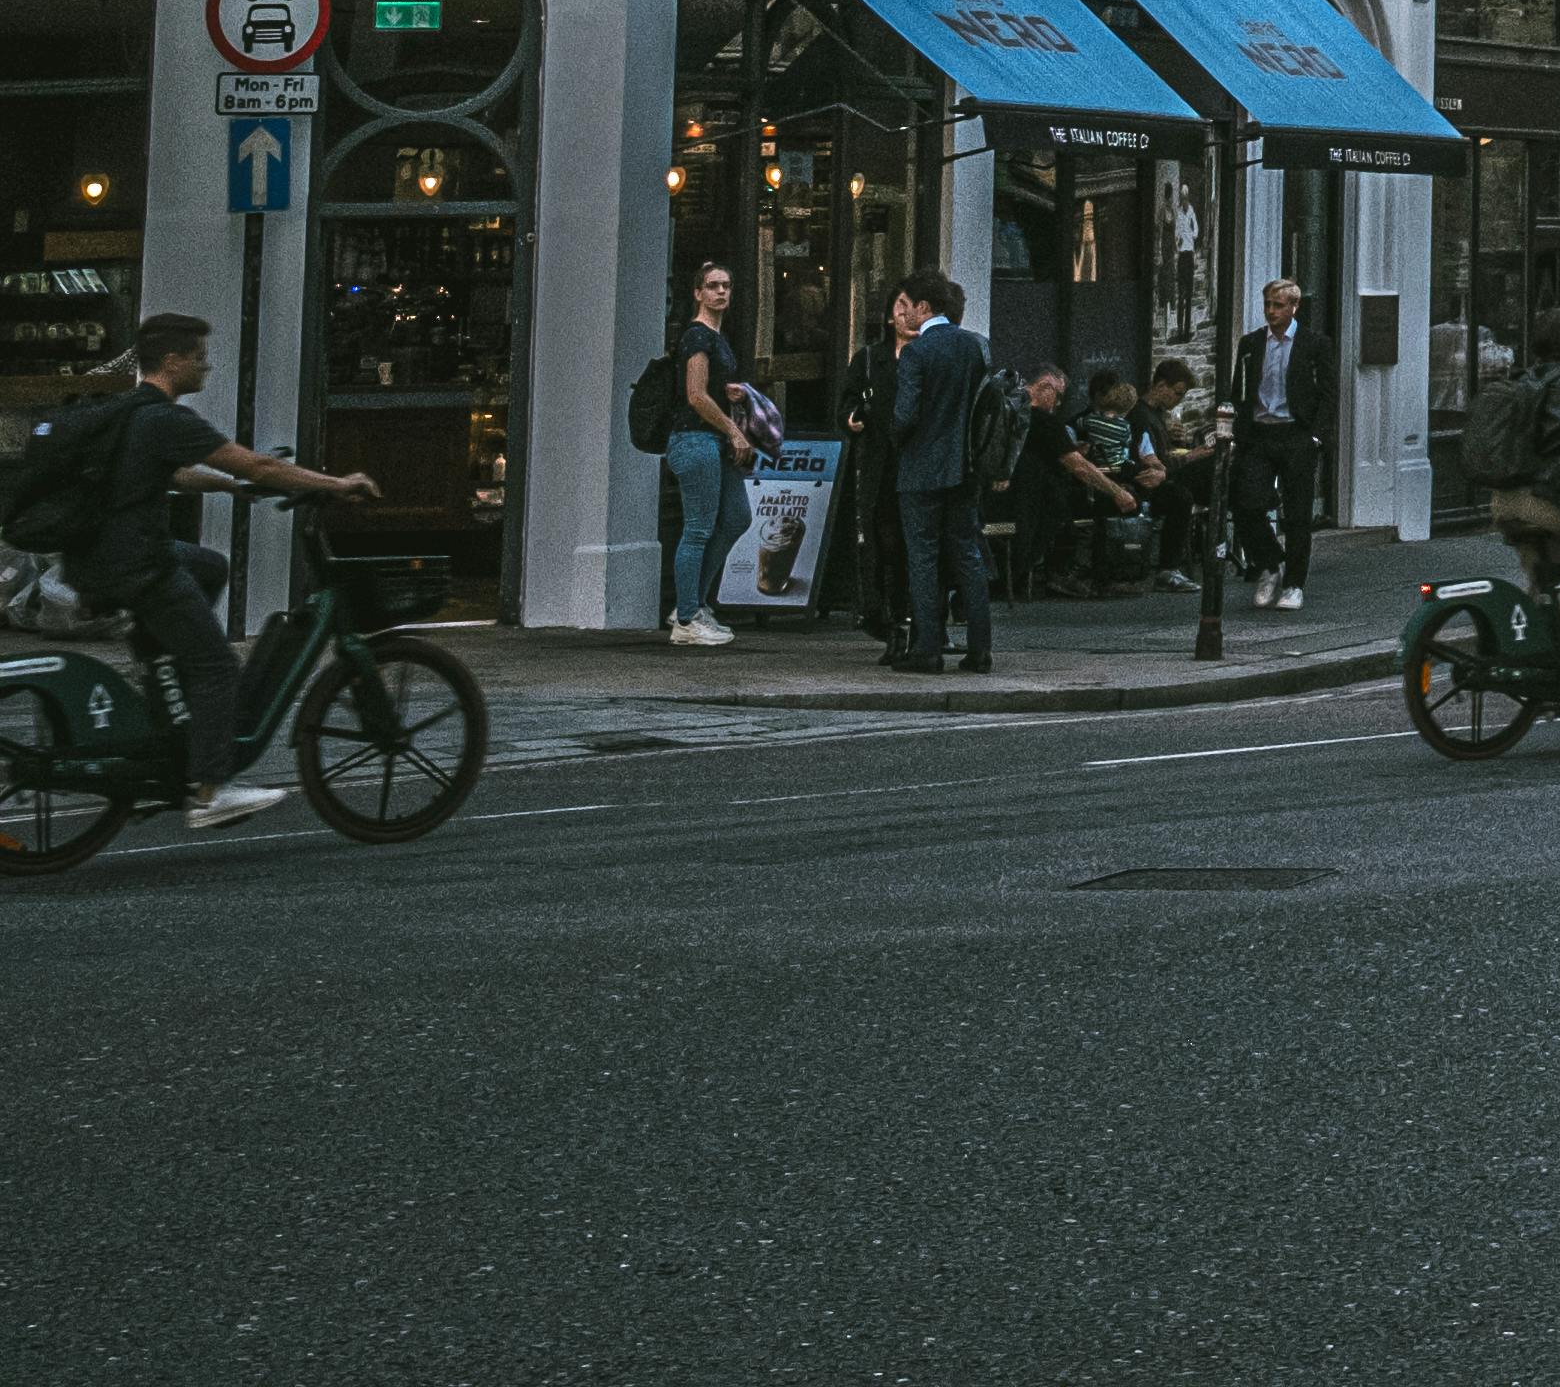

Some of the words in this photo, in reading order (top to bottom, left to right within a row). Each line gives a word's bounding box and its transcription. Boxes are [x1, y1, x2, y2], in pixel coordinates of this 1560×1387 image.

[932, 10, 1080, 53] NERO
[234, 78, 270, 92] Mon
[283, 78, 304, 92] Fri
[1050, 127, 1067, 143] THE
[1070, 128, 1103, 145] ITALIAN
[1106, 131, 1137, 148] COFFEE
[1329, 148, 1342, 162] THE
[1345, 149, 1372, 163] ITALIAN
[1375, 151, 1401, 166] COFFEE
[759, 457, 827, 472] NERO
[759, 495, 809, 506] AMARETTO
